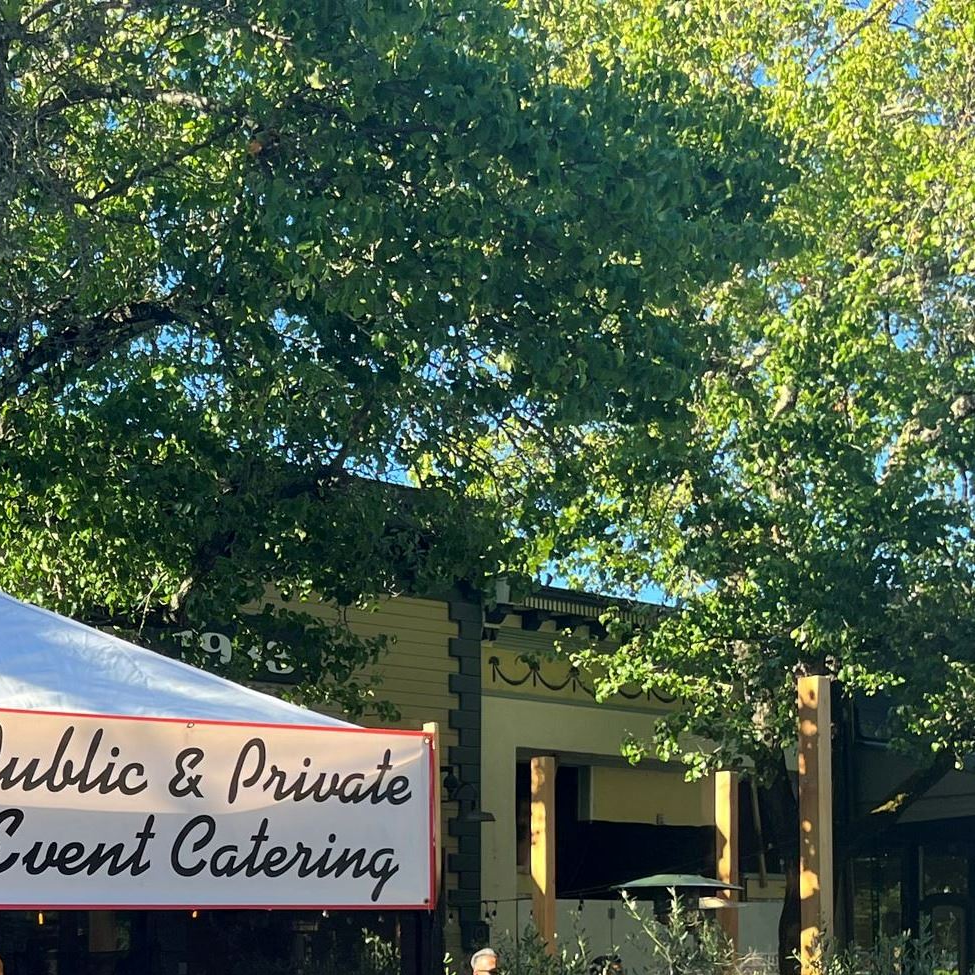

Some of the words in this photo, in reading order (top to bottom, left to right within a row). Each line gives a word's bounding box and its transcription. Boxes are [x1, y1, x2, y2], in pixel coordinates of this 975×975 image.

[168, 747, 205, 798] &
[228, 738, 412, 805] Private
[170, 814, 400, 902] Catering
